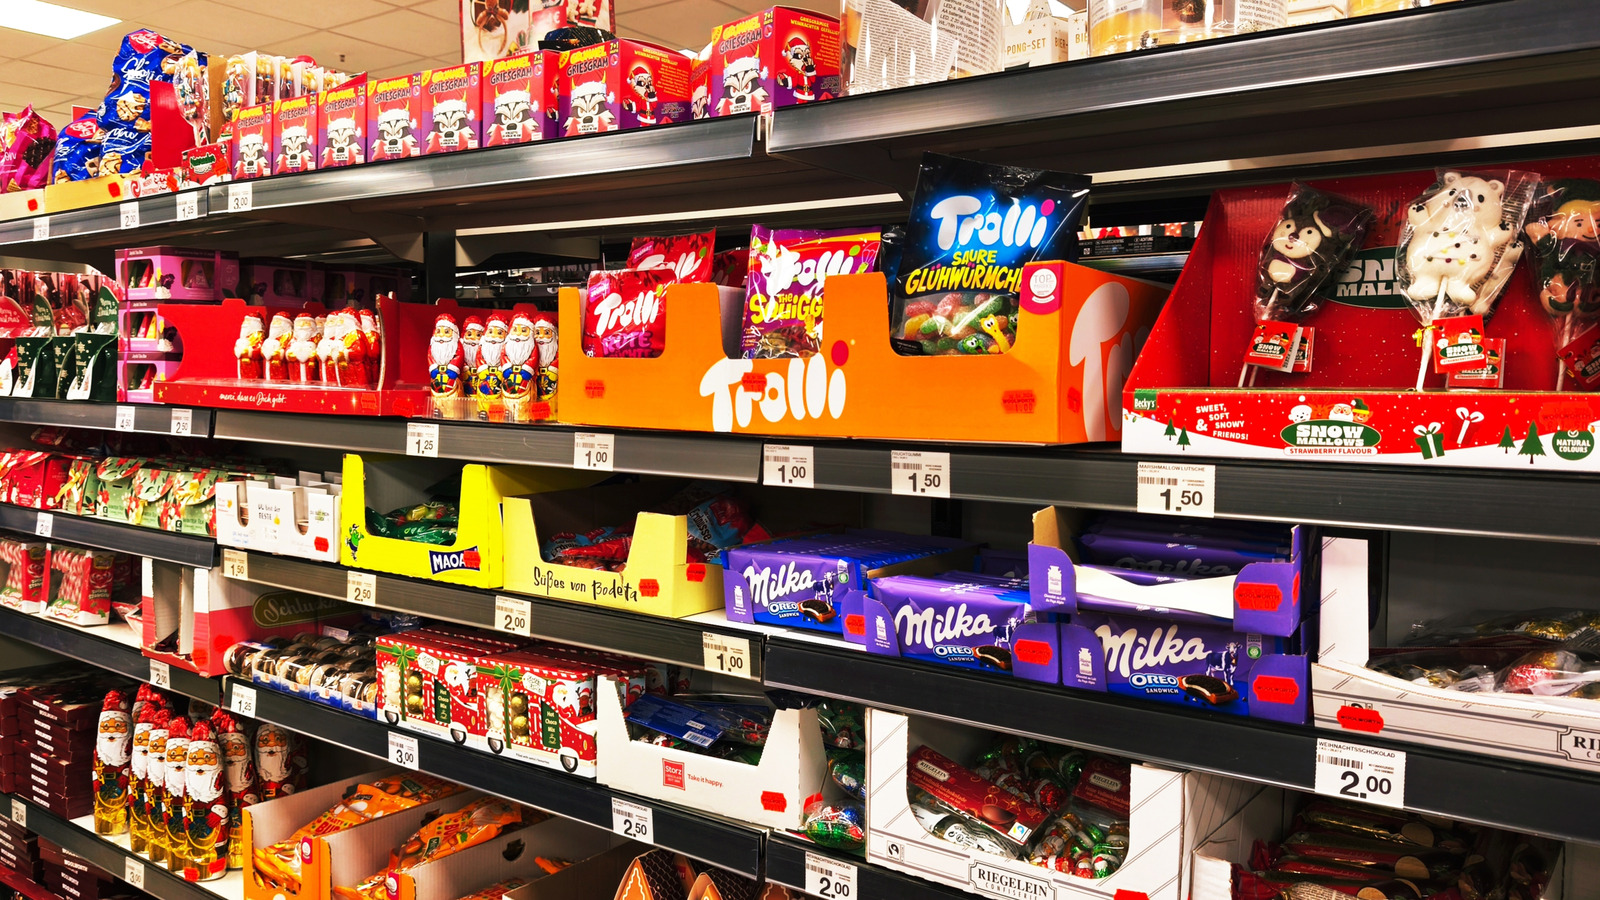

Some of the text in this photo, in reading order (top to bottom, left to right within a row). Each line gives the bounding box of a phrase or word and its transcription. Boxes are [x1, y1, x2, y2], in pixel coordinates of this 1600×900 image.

[719, 29, 762, 54] GRIESGRAM
[1075, 33, 1088, 44] BIE
[566, 58, 609, 77] GRIESGRAM
[490, 68, 533, 85] GRIESGRAM
[429, 78, 469, 95] GRIESGRAM
[374, 88, 412, 104] GRIESGRAM
[324, 98, 357, 113] GRIESGRAM
[233, 197, 248, 210] 3.00
[181, 205, 194, 218] 1.25
[931, 195, 1055, 250] Trolli
[951, 249, 998, 267] SAURE
[1033, 274, 1052, 283] TOP
[1336, 282, 1400, 297] MALL
[594, 284, 663, 336] Trolli
[699, 341, 850, 433] Trolli
[256, 391, 272, 406] Dich
[1134, 398, 1155, 410] Becky's
[1195, 403, 1227, 414] SWEET,
[1208, 412, 1230, 421] SOFT
[175, 421, 189, 434] 2.50
[1195, 418, 1208, 431] &
[1214, 420, 1245, 429] SNOWY
[1296, 424, 1365, 439] SNOW
[1212, 430, 1249, 440] FRIENDS!
[1296, 437, 1365, 447] MALLOWS
[1556, 438, 1591, 447] NATURAL
[415, 438, 434, 455] 1.25
[584, 450, 608, 468] 1.00
[777, 464, 807, 484] 1.00
[1138, 463, 1181, 472] MARSHMALLOW
[908, 472, 941, 493] 1.50
[1160, 488, 1203, 512] 1.50
[230, 563, 245, 577] 1.50
[432, 553, 466, 573] MAOA
[533, 566, 638, 602] Süßes von Bodeta
[742, 561, 817, 608] Milka
[354, 587, 371, 602] 2.50
[1238, 592, 1280, 601] WOOLWORTH
[768, 602, 798, 614] OREO
[778, 611, 800, 619] SANDWICH
[504, 614, 526, 631] 2.00
[894, 603, 997, 649] Milka
[935, 645, 972, 656] OREO
[1094, 624, 1212, 678] Milka
[716, 653, 744, 672] 1.00
[156, 672, 168, 685] 2.00
[1131, 674, 1178, 687] OREO
[238, 699, 252, 714] 1.25
[546, 710, 555, 718] Hot
[1340, 715, 1382, 725] WOOLWORTH
[395, 749, 414, 765] 3.00
[1318, 741, 1396, 759] WEIHNACHTSSCHOKOLAD
[664, 765, 682, 776] Storz
[919, 762, 948, 779] RIEGELEIN
[688, 773, 700, 783] Take
[705, 777, 724, 788] happy.
[1092, 774, 1119, 787] RIEGELEIN
[1339, 770, 1392, 800] 2.00
[326, 816, 345, 826] PARTY
[623, 818, 648, 838] 2.50
[63, 859, 89, 872] WOOLWORTH
[129, 870, 142, 884] 3.00
[977, 868, 1048, 898] RIEGELEIN
[819, 876, 850, 899] 2.00
